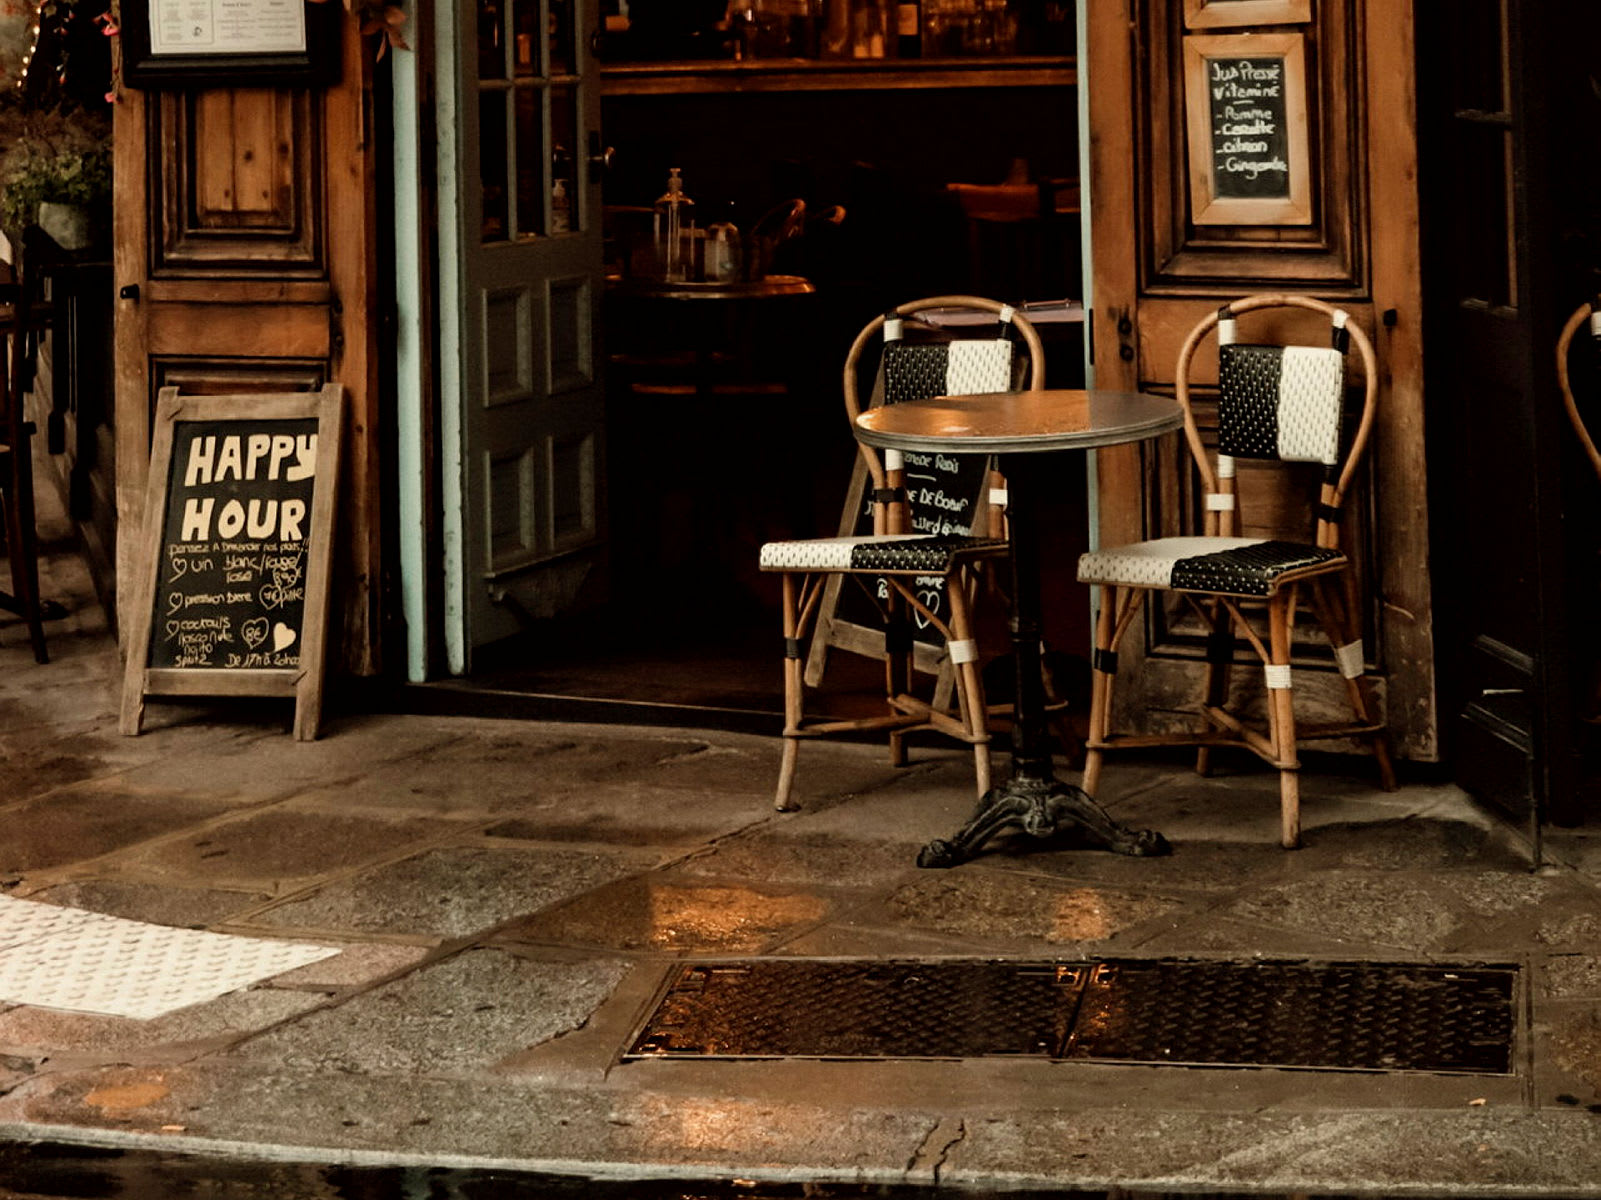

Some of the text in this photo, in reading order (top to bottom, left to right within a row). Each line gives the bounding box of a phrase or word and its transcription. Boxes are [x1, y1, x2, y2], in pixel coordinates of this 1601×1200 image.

[1211, 62, 1239, 81] Jus
[184, 434, 319, 486] HAPPY
[181, 498, 306, 541] HOUR
